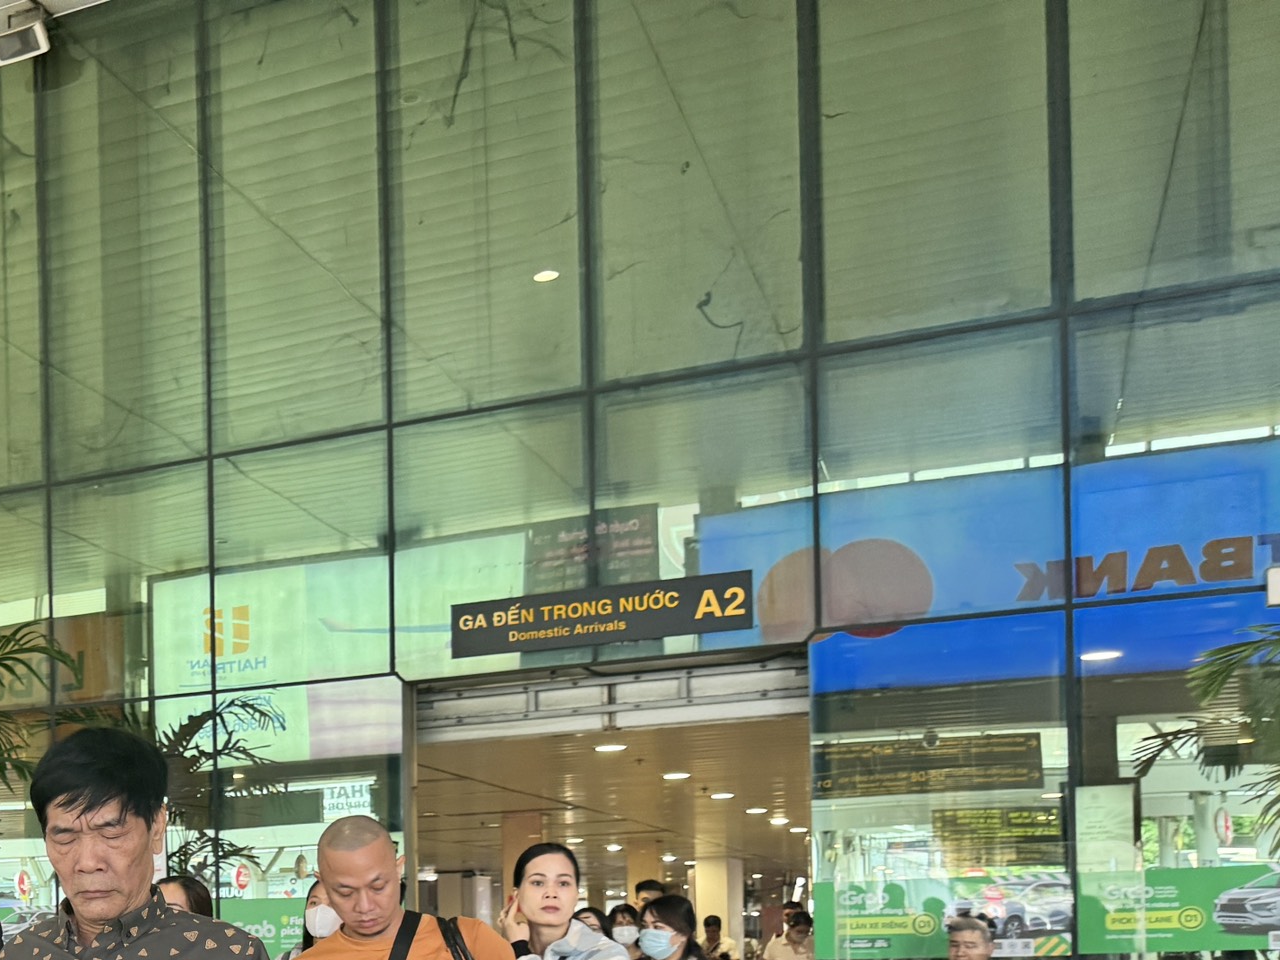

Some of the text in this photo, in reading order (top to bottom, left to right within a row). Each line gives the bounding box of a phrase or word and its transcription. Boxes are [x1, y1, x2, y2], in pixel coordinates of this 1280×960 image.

[459, 588, 681, 631] GA ĐẾN TRONG NƯỚC
[694, 586, 747, 620] A2
[508, 619, 627, 643] Domestic Arrivals
